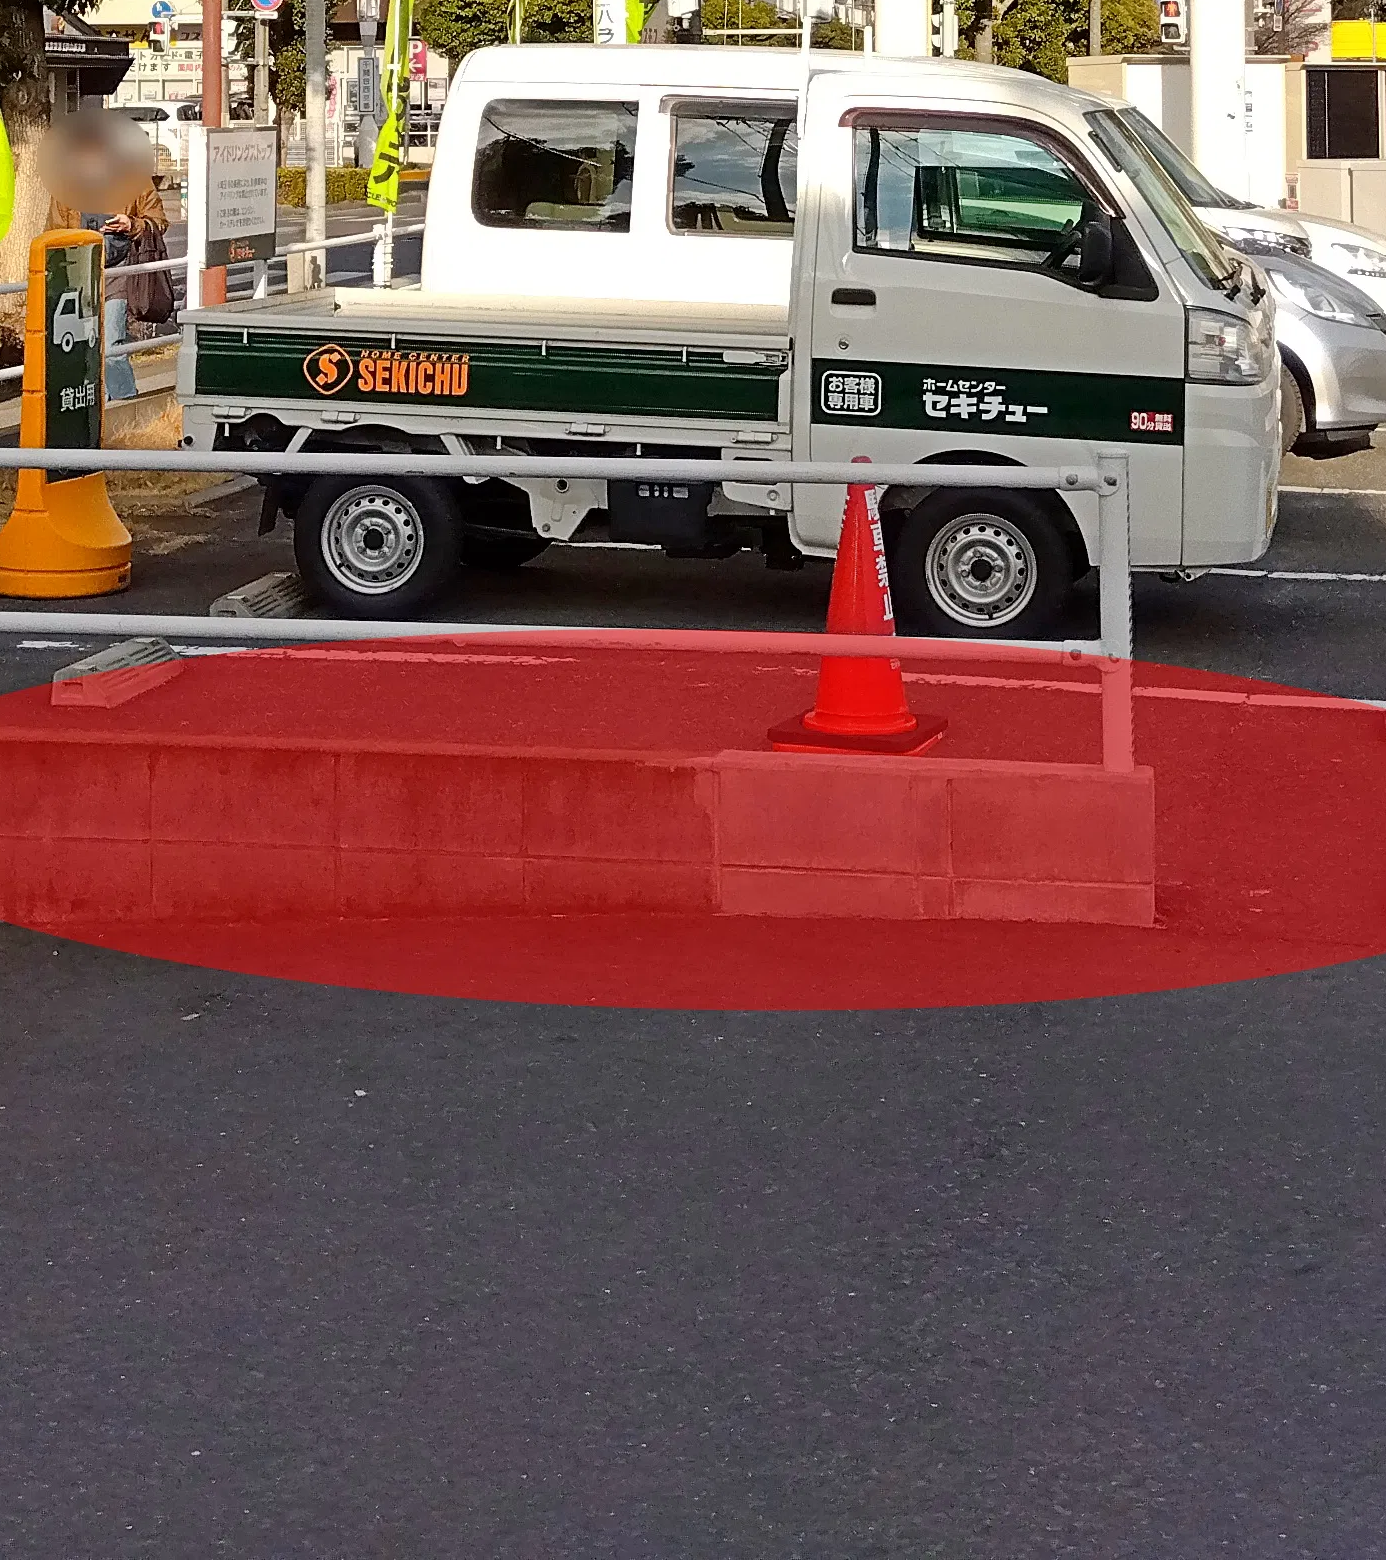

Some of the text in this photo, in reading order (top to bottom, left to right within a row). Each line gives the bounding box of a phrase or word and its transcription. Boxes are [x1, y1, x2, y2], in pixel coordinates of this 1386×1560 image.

[361, 350, 470, 363] HOME CENTER
[358, 358, 470, 396] SEKICHU
[829, 376, 876, 394] お客様
[922, 378, 1006, 393] ホームセンター
[827, 393, 875, 411] 専用車
[922, 391, 1048, 423] セキチュー
